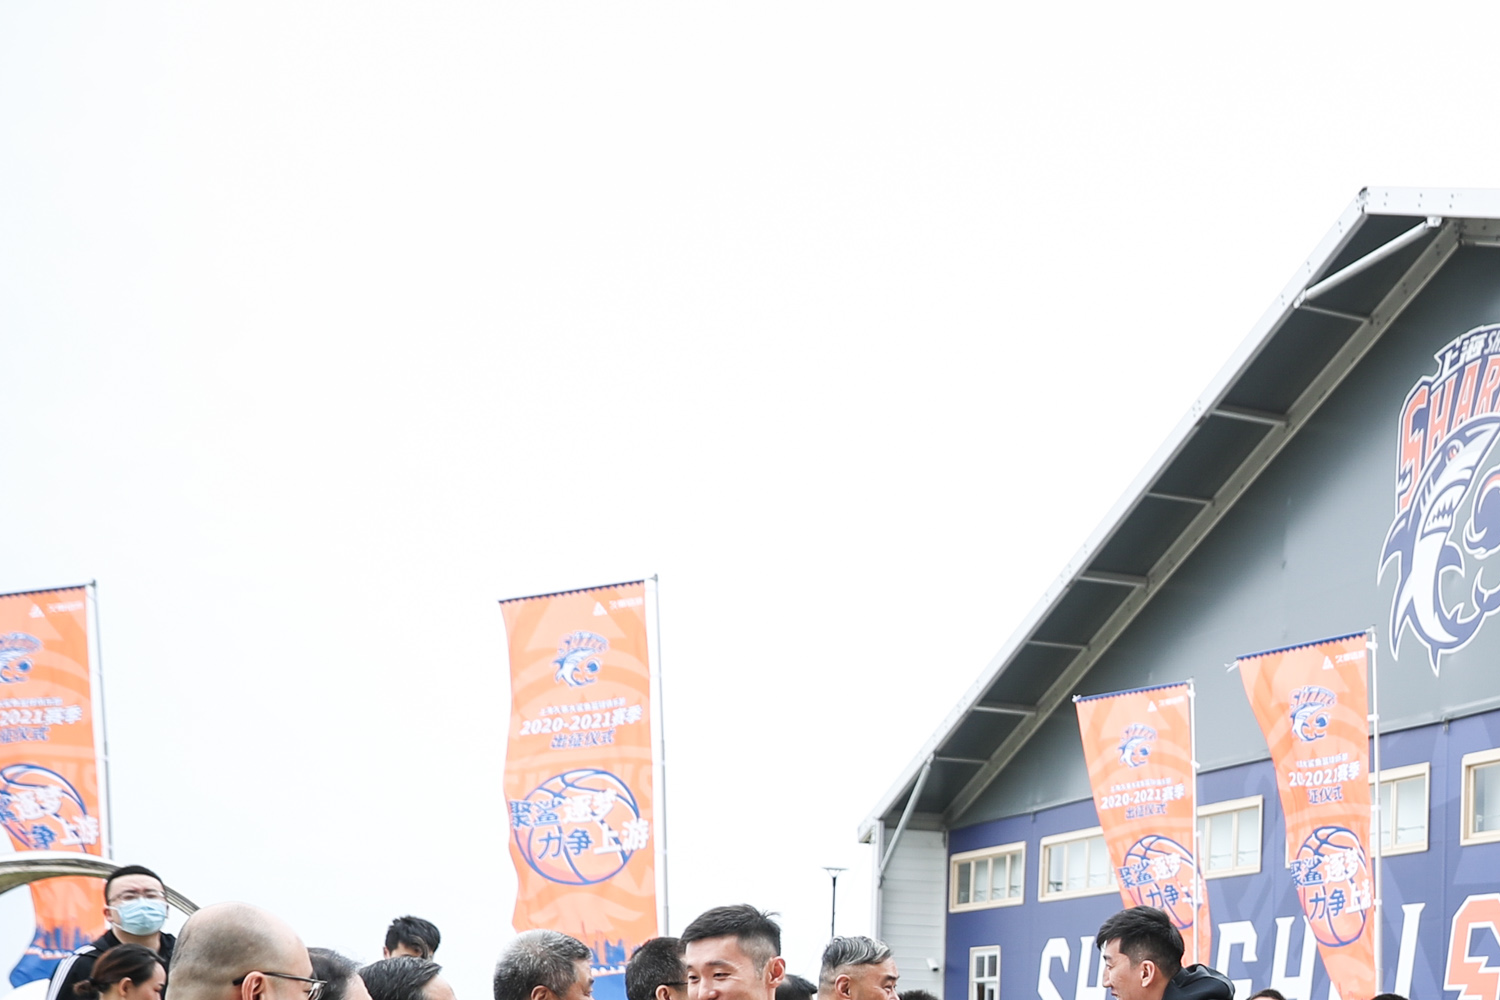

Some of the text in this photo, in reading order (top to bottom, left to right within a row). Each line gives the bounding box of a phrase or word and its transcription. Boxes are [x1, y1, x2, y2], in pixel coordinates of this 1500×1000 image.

[1431, 331, 1488, 391] 上海
[519, 704, 642, 735] 2020-2021赛季
[510, 787, 618, 829] 聚鲨逐梦
[1100, 783, 1185, 810] 2020-2021赛季
[537, 818, 650, 860] 力争上游
